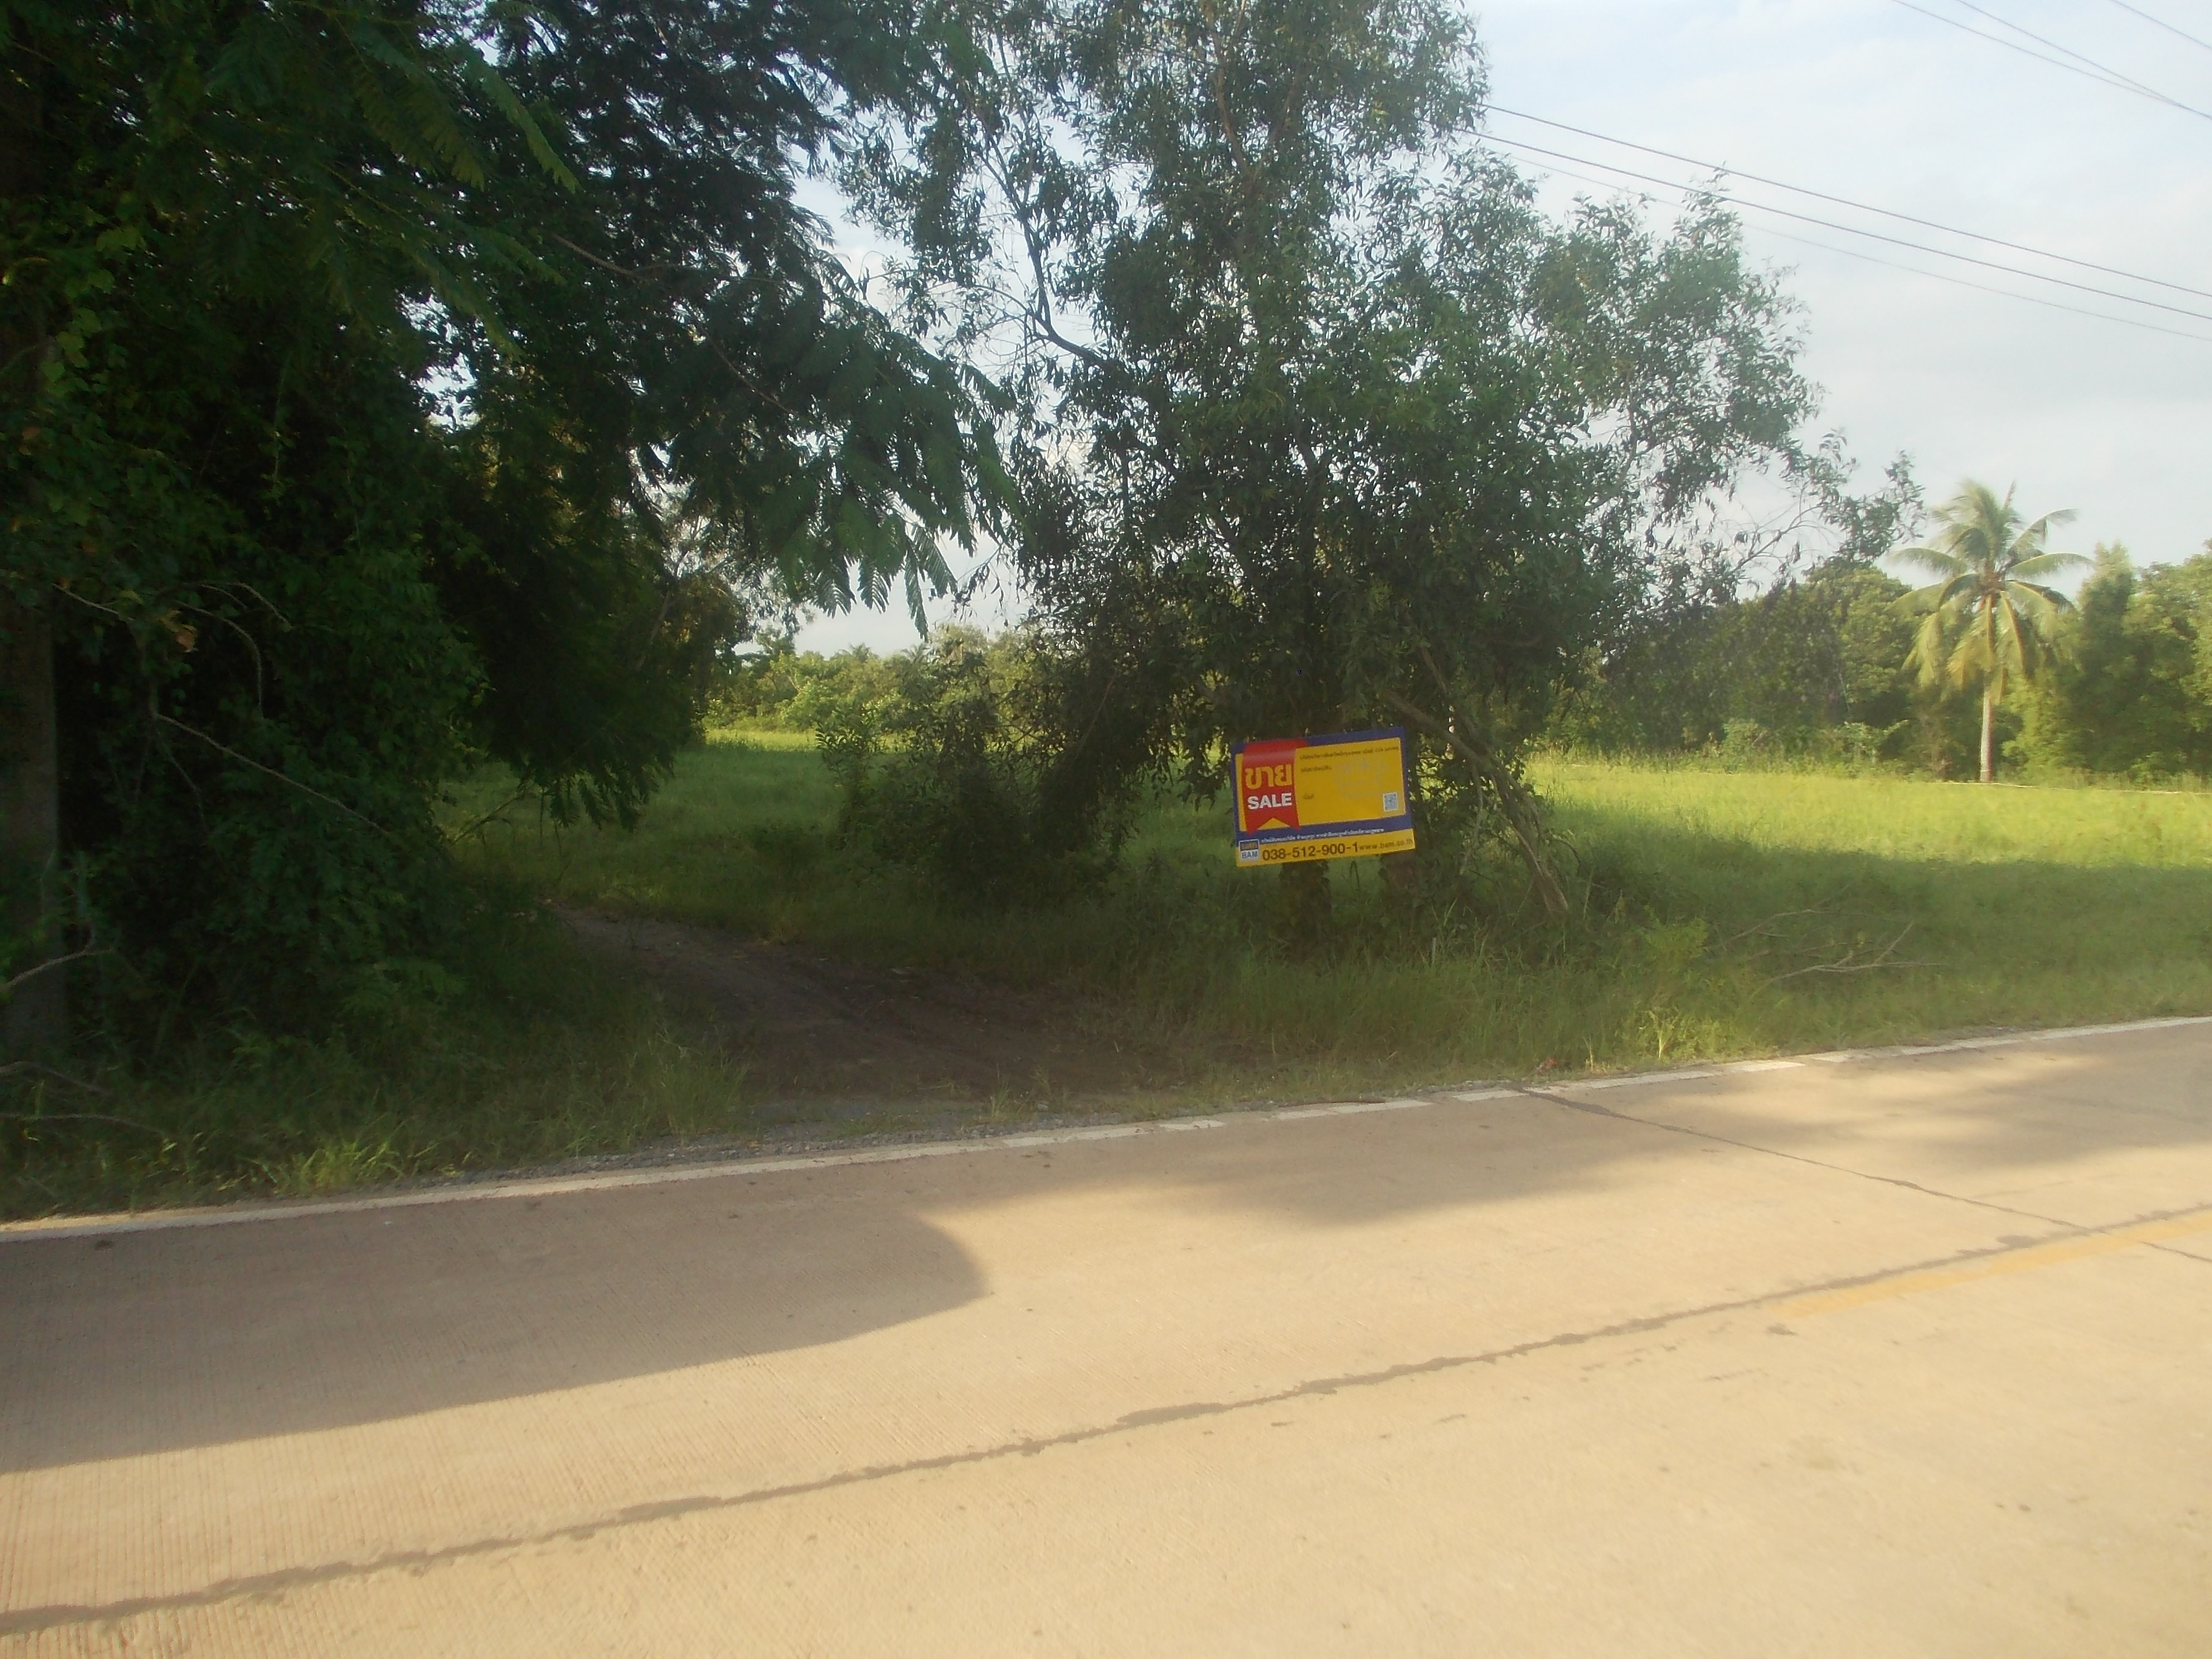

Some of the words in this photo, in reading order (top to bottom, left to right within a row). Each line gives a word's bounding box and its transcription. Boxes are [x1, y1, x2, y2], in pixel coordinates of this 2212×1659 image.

[1245, 764, 1292, 789] ขาย
[1247, 793, 1292, 809] SALE
[1242, 851, 1258, 859] BAM
[1262, 842, 1358, 861] 038-512-900-1
[1359, 839, 1413, 850] www.bam.co.th
